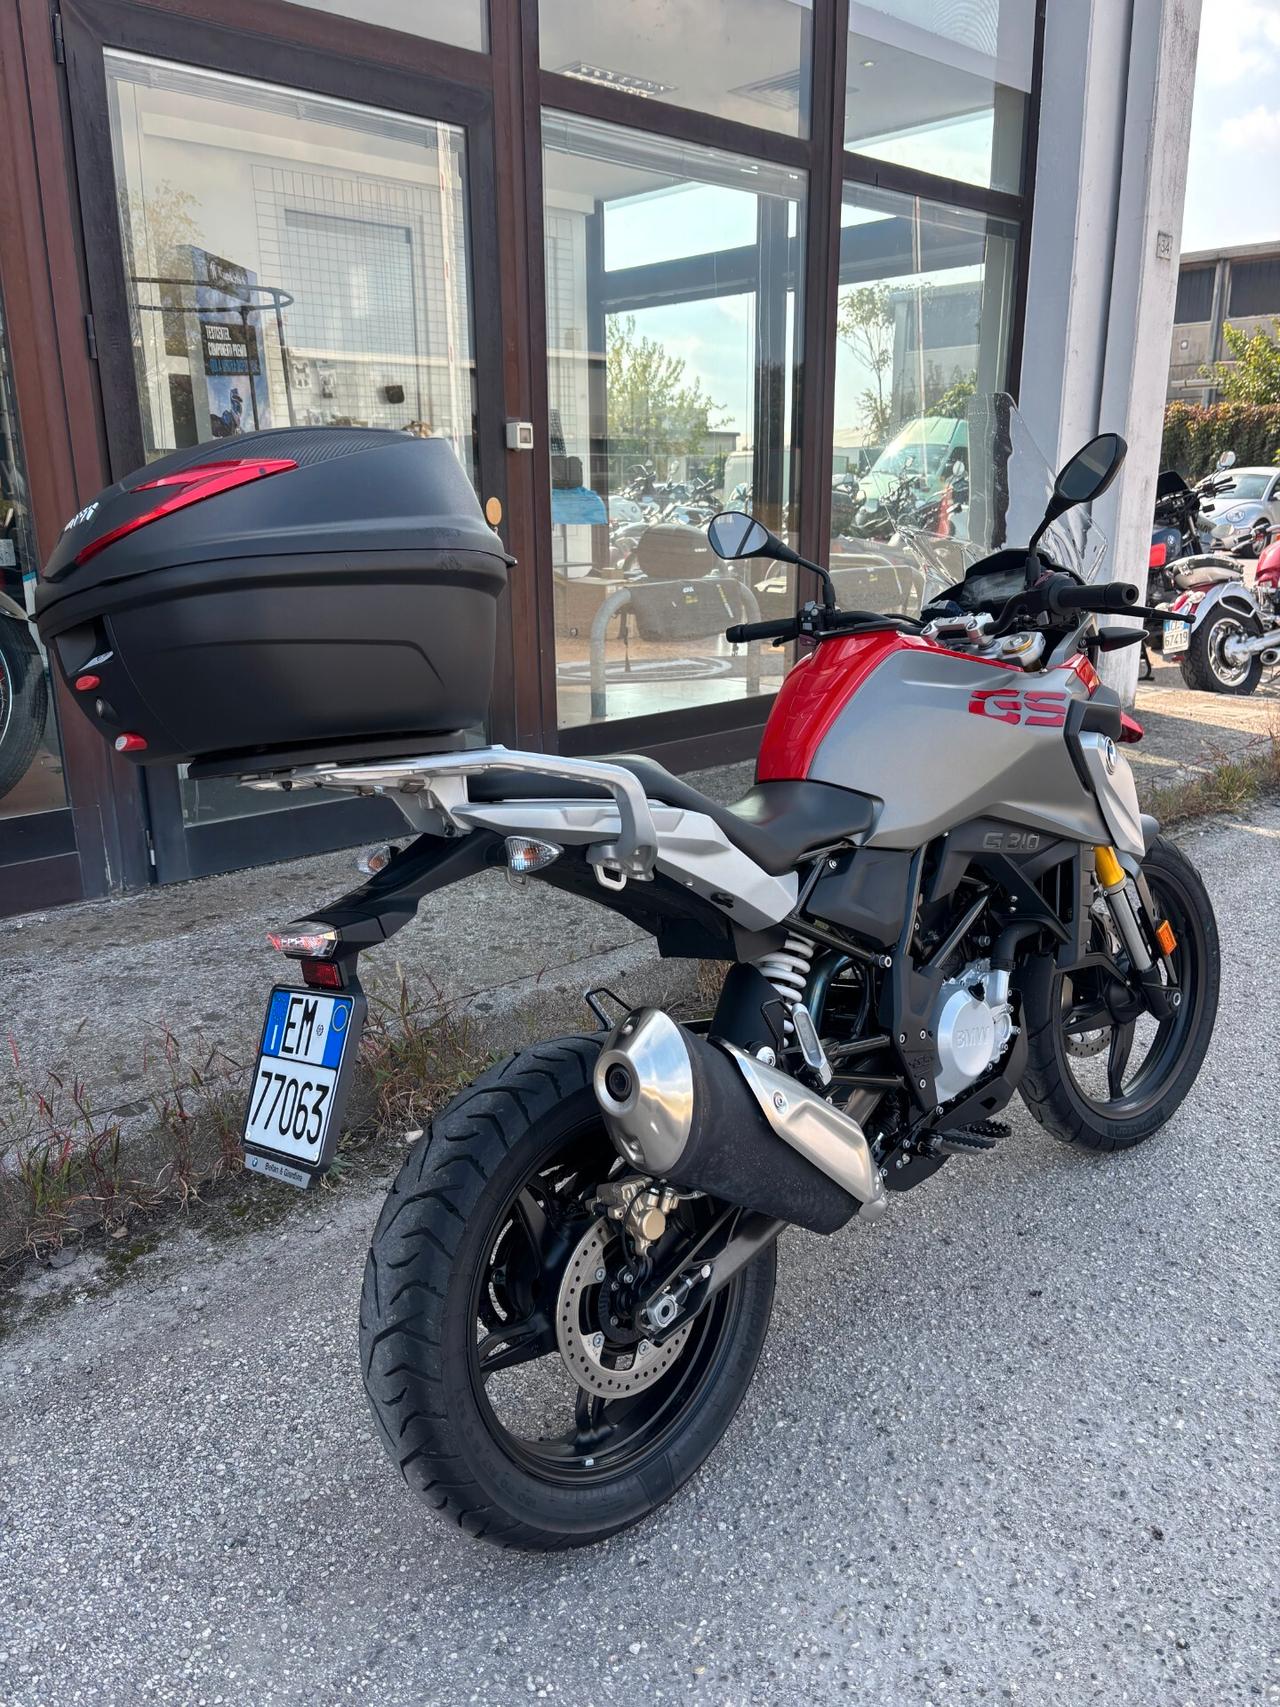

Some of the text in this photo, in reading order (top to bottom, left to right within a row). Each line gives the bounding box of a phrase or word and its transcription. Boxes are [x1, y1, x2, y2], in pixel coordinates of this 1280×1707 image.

[1164, 631, 1188, 647] 67419
[968, 688, 1067, 728] GS
[982, 832, 1040, 850] G 310
[281, 996, 319, 1057] EM
[955, 1025, 992, 1049] BMW
[250, 1070, 330, 1145] 77063
